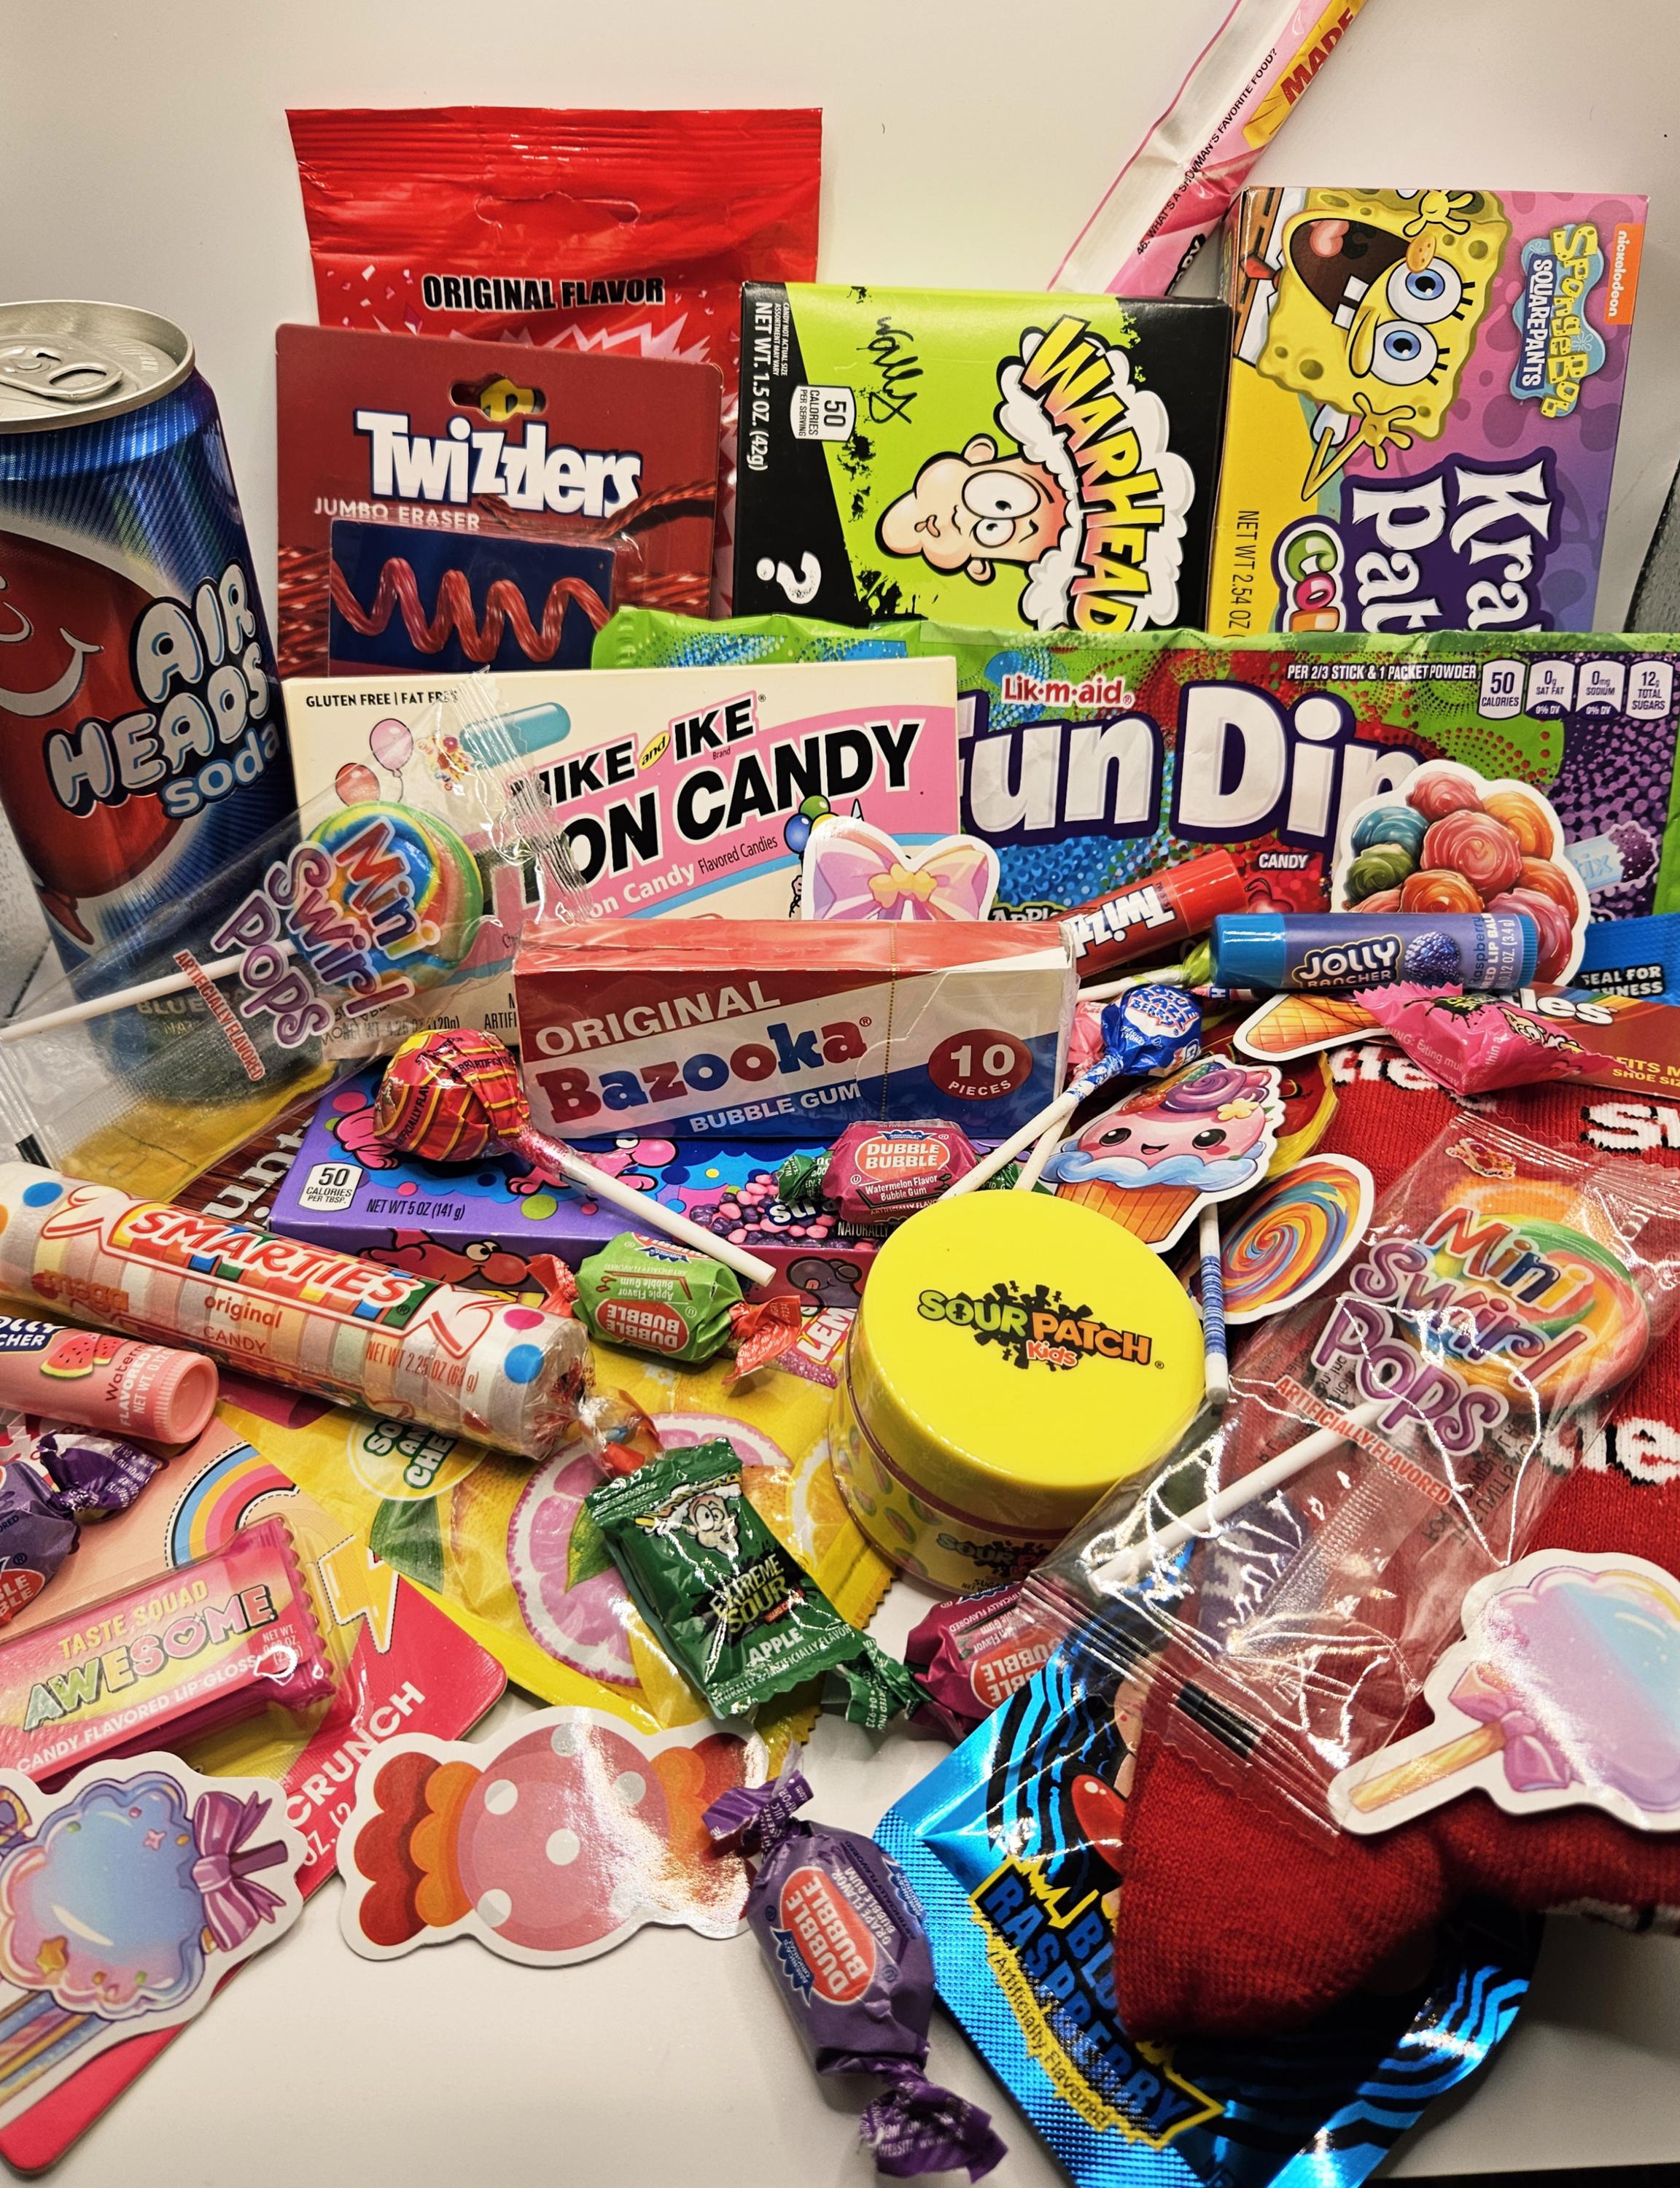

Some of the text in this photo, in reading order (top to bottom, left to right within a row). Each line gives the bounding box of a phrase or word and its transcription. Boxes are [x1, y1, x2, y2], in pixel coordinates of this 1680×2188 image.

[1137, 47, 1278, 255] 46. WHAT'S A FAVORITE FOOD?
[423, 275, 665, 310] ORIGINAL FLAVOR
[1609, 229, 1628, 318] nickelodeon
[1521, 257, 1553, 387] SQUAREPANTS
[747, 302, 773, 471] NET WT. 1.5 OZ. (42g)
[799, 389, 808, 436] PER SERVING
[809, 389, 820, 435] CALORIES
[823, 400, 847, 427] 50
[356, 409, 642, 519] Twizzlers
[1021, 317, 1165, 632] WARHEAD
[314, 497, 481, 530] JUMBO ERASER
[1352, 476, 1447, 632] Pat
[1450, 459, 1553, 632] Kra
[1229, 511, 1260, 631] NET WT 2.54 OZ
[136, 563, 256, 703] AIR
[1288, 664, 1477, 680] PER 2/3 STICK & PACKET POWDER
[1490, 672, 1515, 694] 50
[1536, 686, 1565, 695] SAT FAT
[1544, 670, 1557, 686] 0g
[1586, 687, 1616, 696] SODIUM
[1591, 670, 1611, 687] 0mg
[1641, 671, 1660, 688] 12g
[306, 691, 425, 708] GLUTEN FREE FAT
[1482, 697, 1520, 707] CALORIES
[1632, 700, 1666, 710] SUGARS
[1637, 688, 1662, 699] TOTAL
[47, 643, 270, 808] HEADS
[639, 697, 754, 766] and IKE
[167, 719, 281, 817] soda
[712, 745, 731, 760] Brand
[960, 693, 1158, 833] un
[677, 722, 922, 841] CANDY
[623, 837, 779, 904] Candy Flavored Candies
[1259, 853, 1309, 869] CANDY
[337, 818, 439, 958] Mini
[265, 846, 416, 1018] Swirl
[1488, 942, 1499, 963] LIP
[1501, 928, 1518, 963] OZ. (3.4
[1299, 939, 1399, 980] JOLLY
[1307, 969, 1391, 988] RANCHER
[1626, 965, 1662, 981] FOR
[175, 950, 232, 1023] ARTIFICIALLY
[225, 1021, 265, 1081] FLAVORED
[536, 981, 781, 1057] ORIGINAL
[949, 1043, 1016, 1077] 10
[1417, 1039, 1443, 1063] Eating
[1616, 1057, 1661, 1074] FITS
[536, 1023, 868, 1126] Bazooka
[948, 1079, 1012, 1097] PIECES
[1612, 1068, 1656, 1083] SHOE
[690, 1082, 862, 1133] BUBBLE GUM
[865, 1155, 938, 1169] BUBBLE
[866, 1143, 940, 1155] DUBBLE
[306, 1187, 353, 1198] CALORIES
[318, 1168, 350, 1187] 50
[865, 1173, 938, 1195] Watermelon Flavor
[880, 1187, 927, 1202] Bubble Gum
[307, 1195, 348, 1204] PER TBSP.
[366, 1199, 467, 1221] NET WT 5 OZ (141 g)
[129, 1208, 421, 1309] SMARTIES
[1421, 1208, 1595, 1312] Mini
[42, 1269, 129, 1311] mega
[618, 1286, 674, 1301] Apple Flavor
[621, 1276, 674, 1289] Bubble Gum
[203, 1296, 281, 1329] original
[607, 1304, 680, 1335] BUBBLE
[918, 1289, 1151, 1365] SOUR PATCH
[1350, 1238, 1595, 1389] Swirl
[203, 1325, 265, 1354] CANDY
[607, 1319, 678, 1349] DUBBLE
[796, 1306, 854, 1362] LEM
[1026, 1339, 1078, 1368] Kids
[367, 1340, 467, 1387] NET WT 2.25 OZ (63
[119, 1349, 153, 1427] FLAVORED
[132, 1368, 156, 1415] NET WT.
[1275, 1376, 1374, 1451] ARTIFICIALLY
[1371, 1439, 1452, 1506] FLAVORED
[936, 1533, 1014, 1564] SOUR
[709, 1554, 785, 1617] EXTREME
[726, 1576, 793, 1634] SOUR
[59, 1580, 210, 1660] TASTE SQUAD
[262, 1623, 298, 1643] NET WT.
[949, 1604, 992, 1632] FLAVORED
[23, 1584, 279, 1732] AWESOME
[749, 1627, 805, 1665] APPLE
[16, 1656, 256, 1772] CANDY FLAVORED LIP GLOSS
[284, 1680, 426, 1828] CRUNCH
[831, 1868, 893, 1946] GRAPE FLAVOR
[844, 1866, 896, 1935] BUBBLE GUM
[785, 1890, 850, 1995] DUBBLE
[803, 1876, 869, 1980] BUBBLE
[984, 1873, 1191, 2128] RASPBERRY
